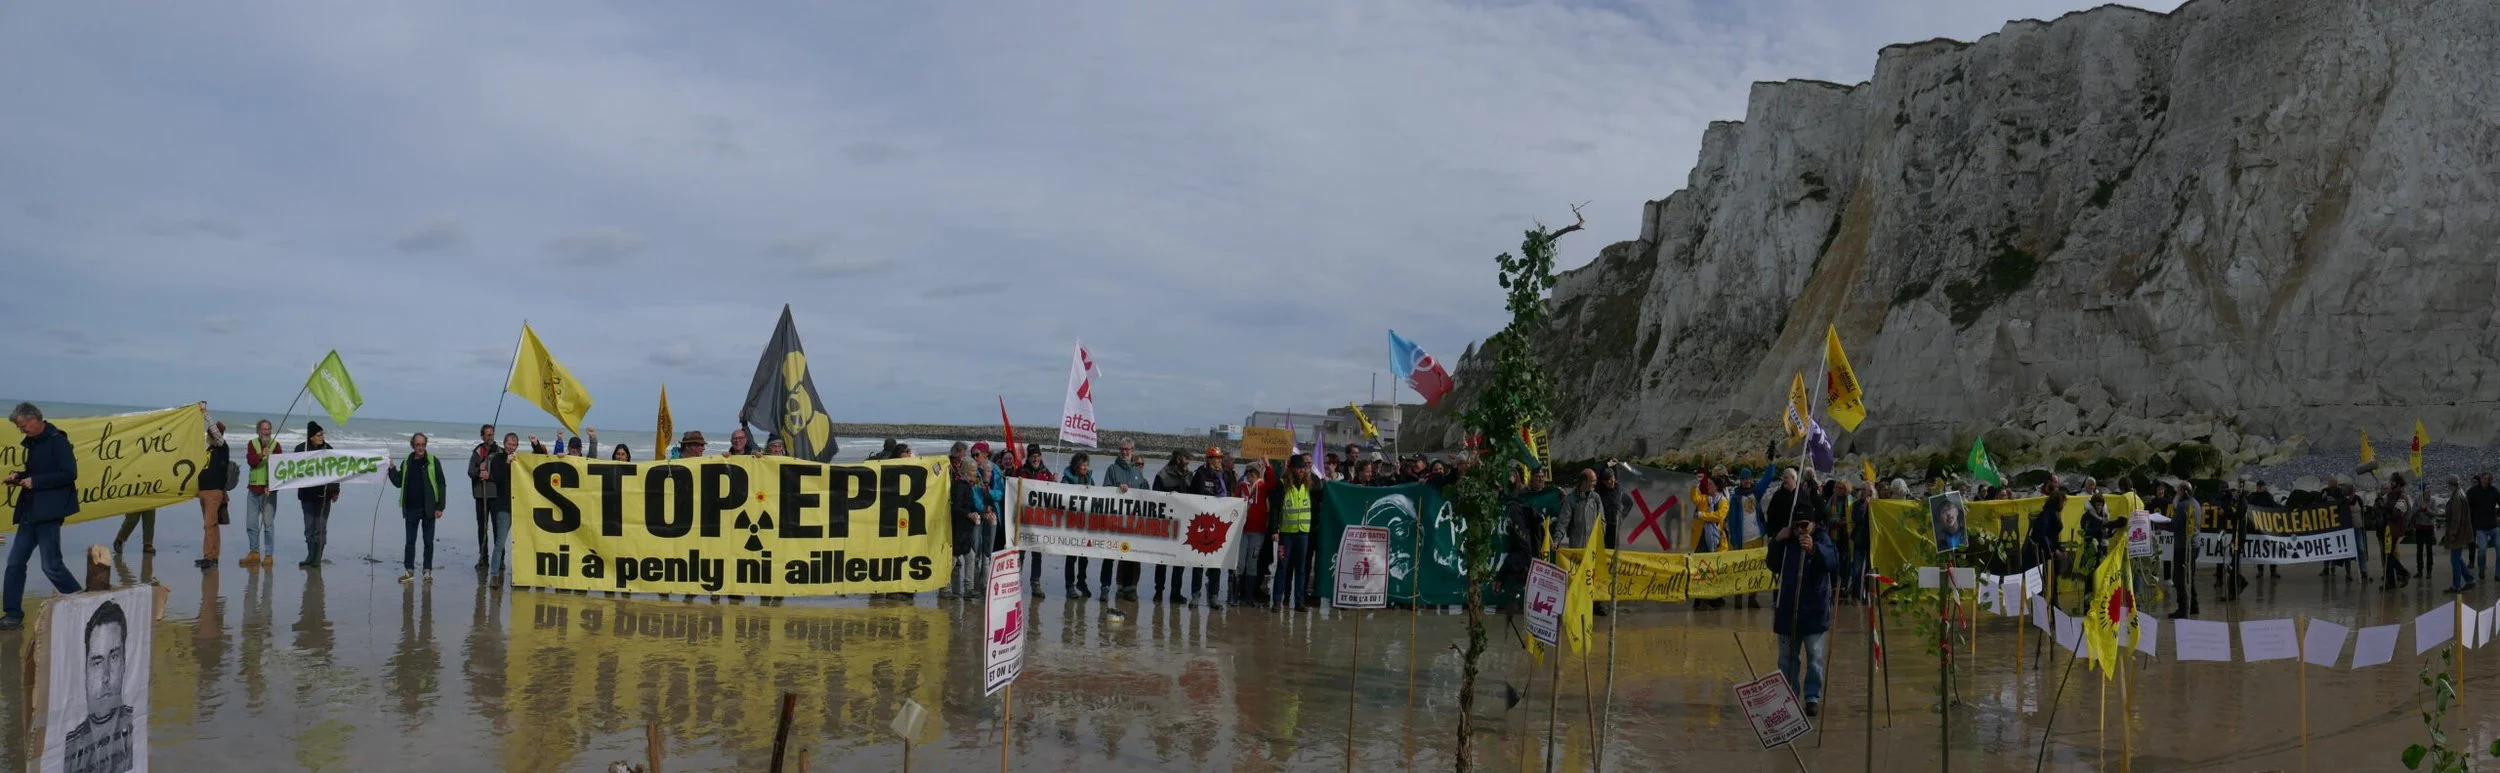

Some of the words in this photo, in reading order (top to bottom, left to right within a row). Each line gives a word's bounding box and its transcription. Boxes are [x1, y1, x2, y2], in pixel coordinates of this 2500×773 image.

[92, 421, 125, 461] la
[136, 426, 178, 453] vie
[78, 463, 170, 505] ucléaire
[274, 456, 383, 481] GREENPEACE
[533, 462, 749, 537] STOP
[778, 461, 928, 539] EPR
[1028, 490, 1065, 511] CIVIL
[1069, 495, 1088, 513] ET
[1091, 496, 1167, 519] MILITAIRE
[1066, 510, 1086, 529] DU
[2251, 503, 2342, 534] NUCLÉAIRE
[1042, 535, 1056, 545] DU
[1106, 540, 1119, 551] 34
[536, 545, 570, 578] ni
[582, 549, 605, 579] à
[615, 550, 725, 592] penly
[735, 551, 772, 584] ni
[784, 550, 932, 585] ailleurs
